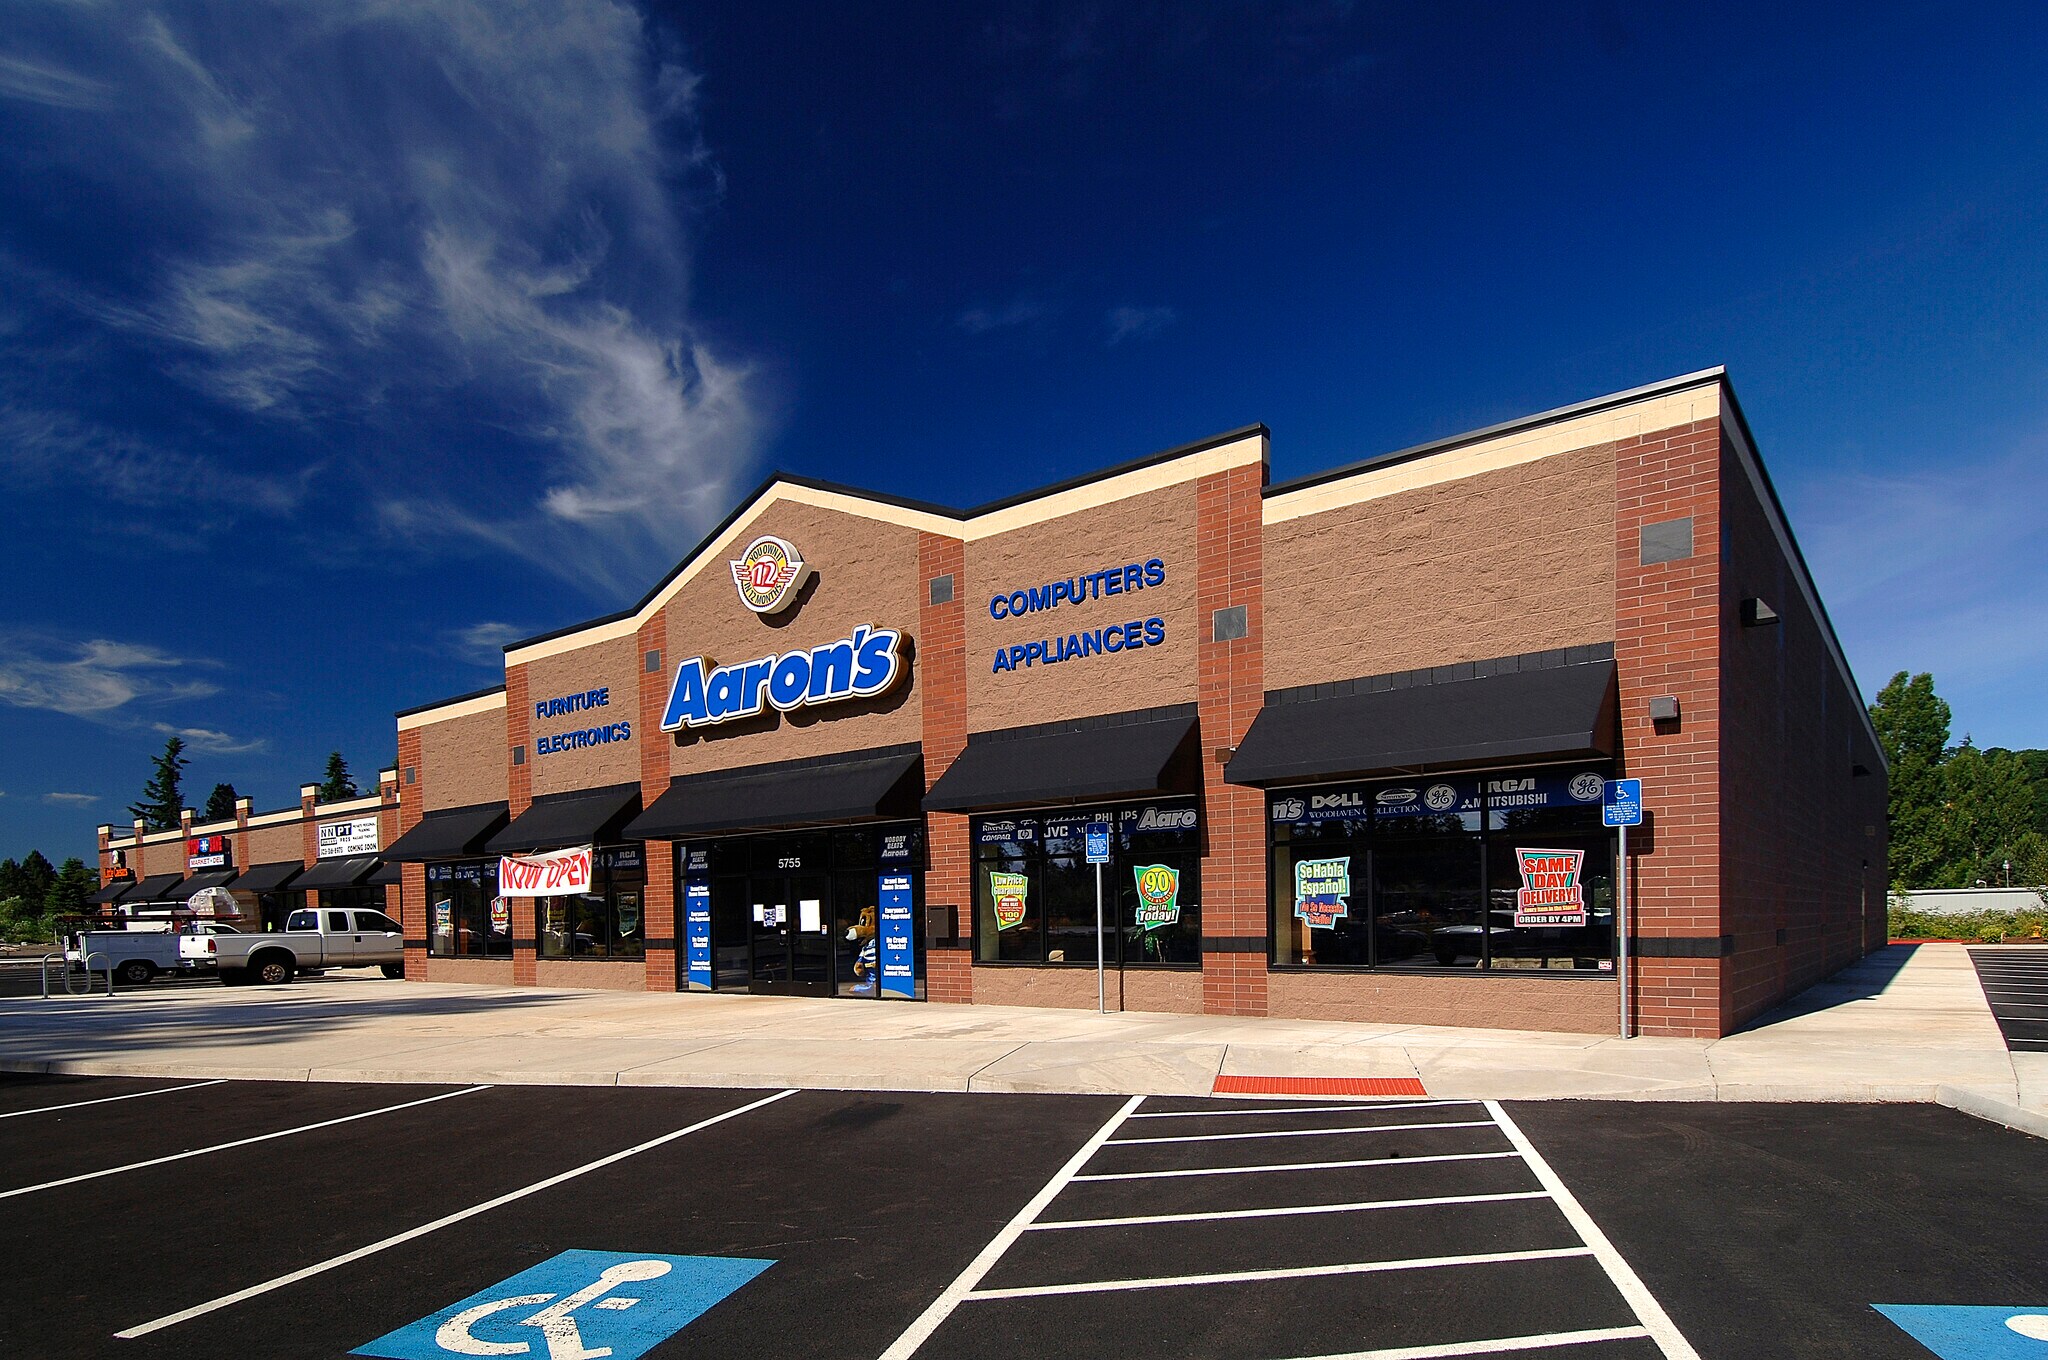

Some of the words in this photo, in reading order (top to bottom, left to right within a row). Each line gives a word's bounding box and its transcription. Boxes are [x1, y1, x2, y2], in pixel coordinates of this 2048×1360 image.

[750, 546, 763, 562] YOU
[763, 544, 778, 556] OWN
[777, 551, 784, 562] IT
[752, 561, 777, 587] 12
[744, 582, 751, 592] IN
[748, 590, 757, 601] 12
[755, 584, 782, 604] MONTHS
[989, 557, 1165, 620] COMPUTERS
[992, 617, 1165, 673] APPLIANCES
[661, 625, 897, 729] Aaron's
[536, 688, 609, 719] FURNITURE
[537, 721, 631, 755] ELECTRONICS
[1487, 778, 1536, 793] RCA
[1311, 792, 1363, 809] DELL
[1308, 808, 1361, 819] WOODHAVEN
[1043, 826, 1068, 838] JVC
[348, 844, 363, 852] COMING
[620, 850, 636, 858] RCA
[887, 842, 904, 850] BEATS
[191, 858, 210, 866] MARKET
[502, 858, 543, 889] NOW
[546, 850, 592, 888] OPEN
[778, 858, 800, 868] 5755
[1300, 864, 1312, 878] Se
[1313, 862, 1344, 878] Habla
[1524, 857, 1575, 873] SAME
[463, 870, 474, 878] JVC
[1008, 876, 1023, 885] Price
[1146, 870, 1169, 892] 90
[1534, 873, 1568, 888] DAY
[1300, 878, 1346, 897] Español!
[1523, 888, 1578, 905] DELIVERY!
[1140, 910, 1176, 921] Today!
